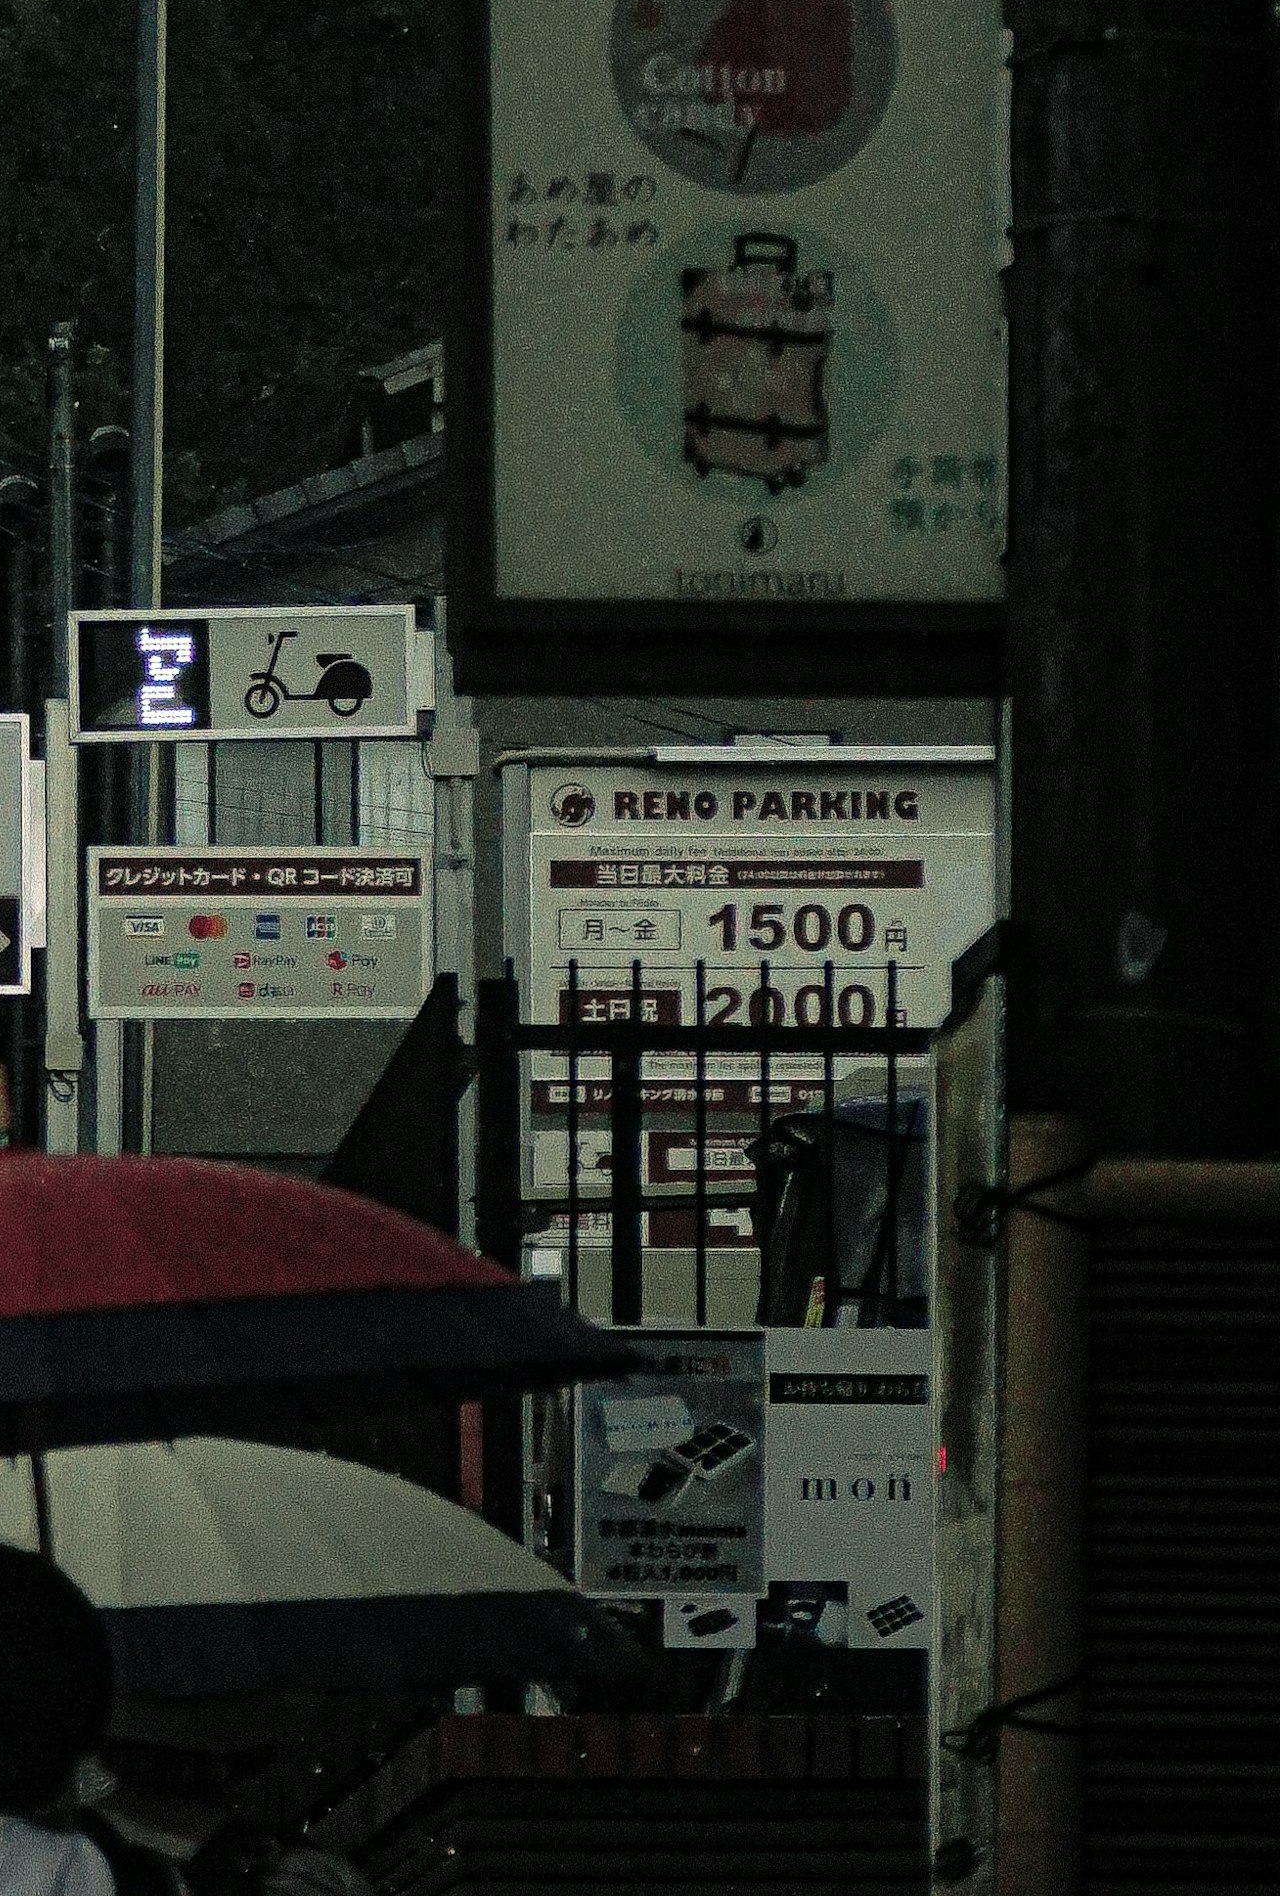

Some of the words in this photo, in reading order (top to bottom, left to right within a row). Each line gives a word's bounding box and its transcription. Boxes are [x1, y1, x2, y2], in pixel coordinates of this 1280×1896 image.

[613, 790, 719, 822] RENO
[732, 790, 919, 822] PARKING
[589, 844, 650, 858] Maximum
[596, 864, 730, 886] 当日最大料金
[130, 920, 160, 934] VISA
[145, 955, 172, 967] LINE
